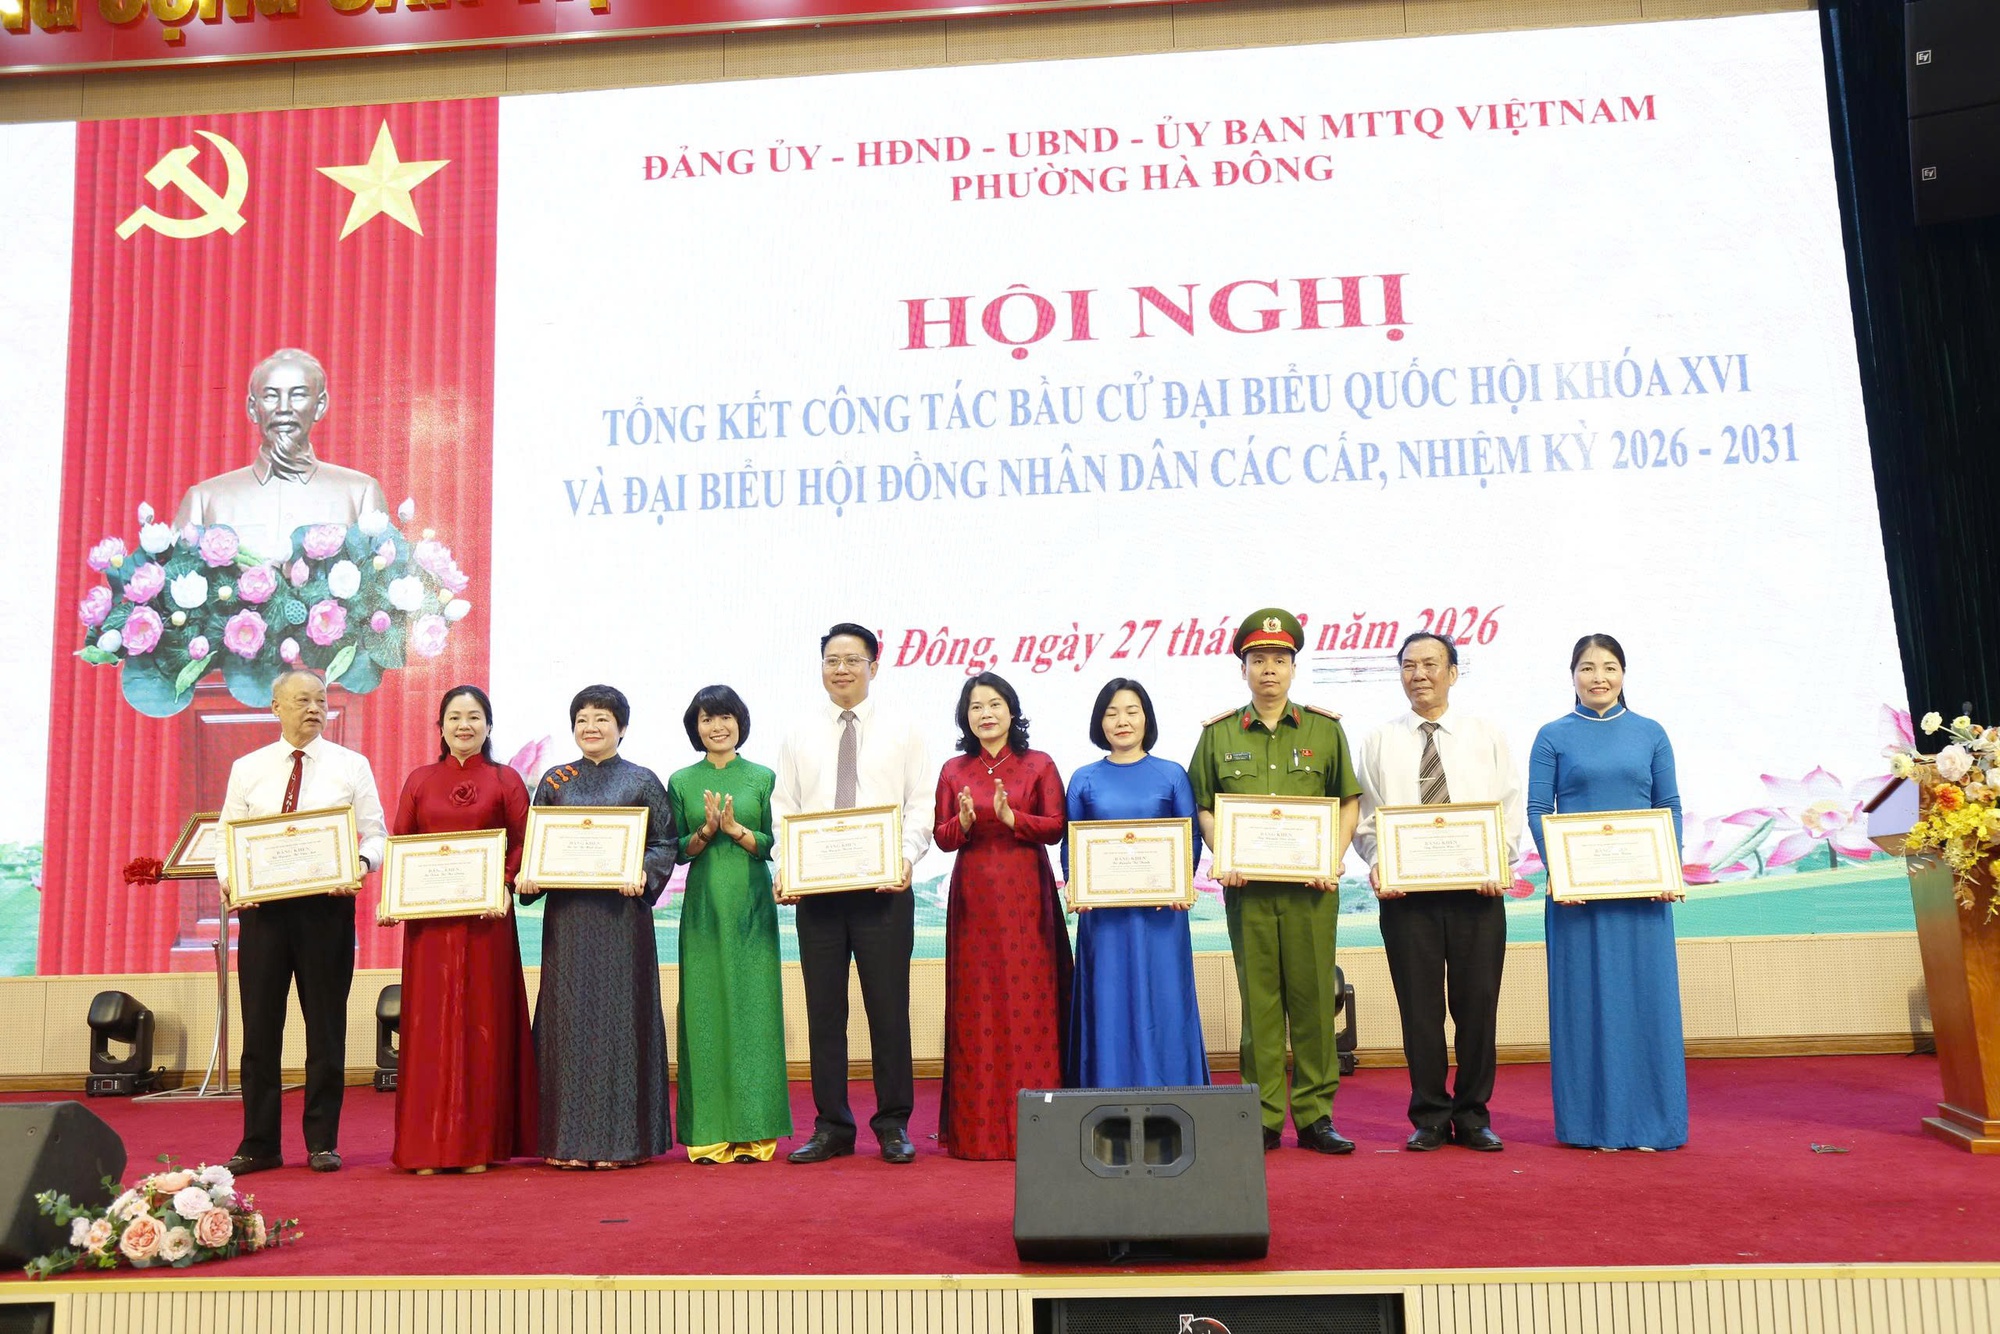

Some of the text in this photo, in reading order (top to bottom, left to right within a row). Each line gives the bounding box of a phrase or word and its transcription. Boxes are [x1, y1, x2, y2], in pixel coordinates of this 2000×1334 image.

[644, 145, 755, 181] ĐẢNG
[768, 139, 823, 173] ỦY
[857, 135, 972, 168] HĐND
[1008, 127, 1120, 159] UBND
[1156, 115, 1212, 150] ỦY
[1224, 115, 1306, 146] BAN
[1321, 107, 1445, 140] MTTQ
[950, 149, 1334, 202] PHƯỜNG HÀ ĐÔNG
[898, 273, 1413, 361] HỘI NGHỊ
[601, 345, 1751, 447] TỔNG KẾT CÔNG TÁC BẦU CỬ ĐẠI BIỂU QUỐC HỘI KHÓA XVI
[562, 465, 613, 517] VÀ
[624, 472, 688, 527] ĐẠI
[699, 462, 786, 512] BIỂU
[798, 459, 866, 519] HỘI
[879, 450, 988, 503] ĐỒNG
[999, 441, 1108, 497] NHÂN
[1119, 437, 1199, 493] DÂN
[1210, 433, 1292, 489] CÁC
[1302, 431, 1389, 490] CẤP,
[1398, 430, 1532, 490] NHIỆM
[1541, 419, 1599, 473] KỲ
[1612, 427, 1689, 470] 2026
[1721, 422, 1799, 466] 2031
[895, 625, 999, 677] Đông,
[1011, 621, 1104, 674] ngày
[1109, 618, 1163, 660] 27
[1166, 615, 1236, 658] thá
[1315, 612, 1400, 652] năm
[1417, 604, 1505, 646] 2026
